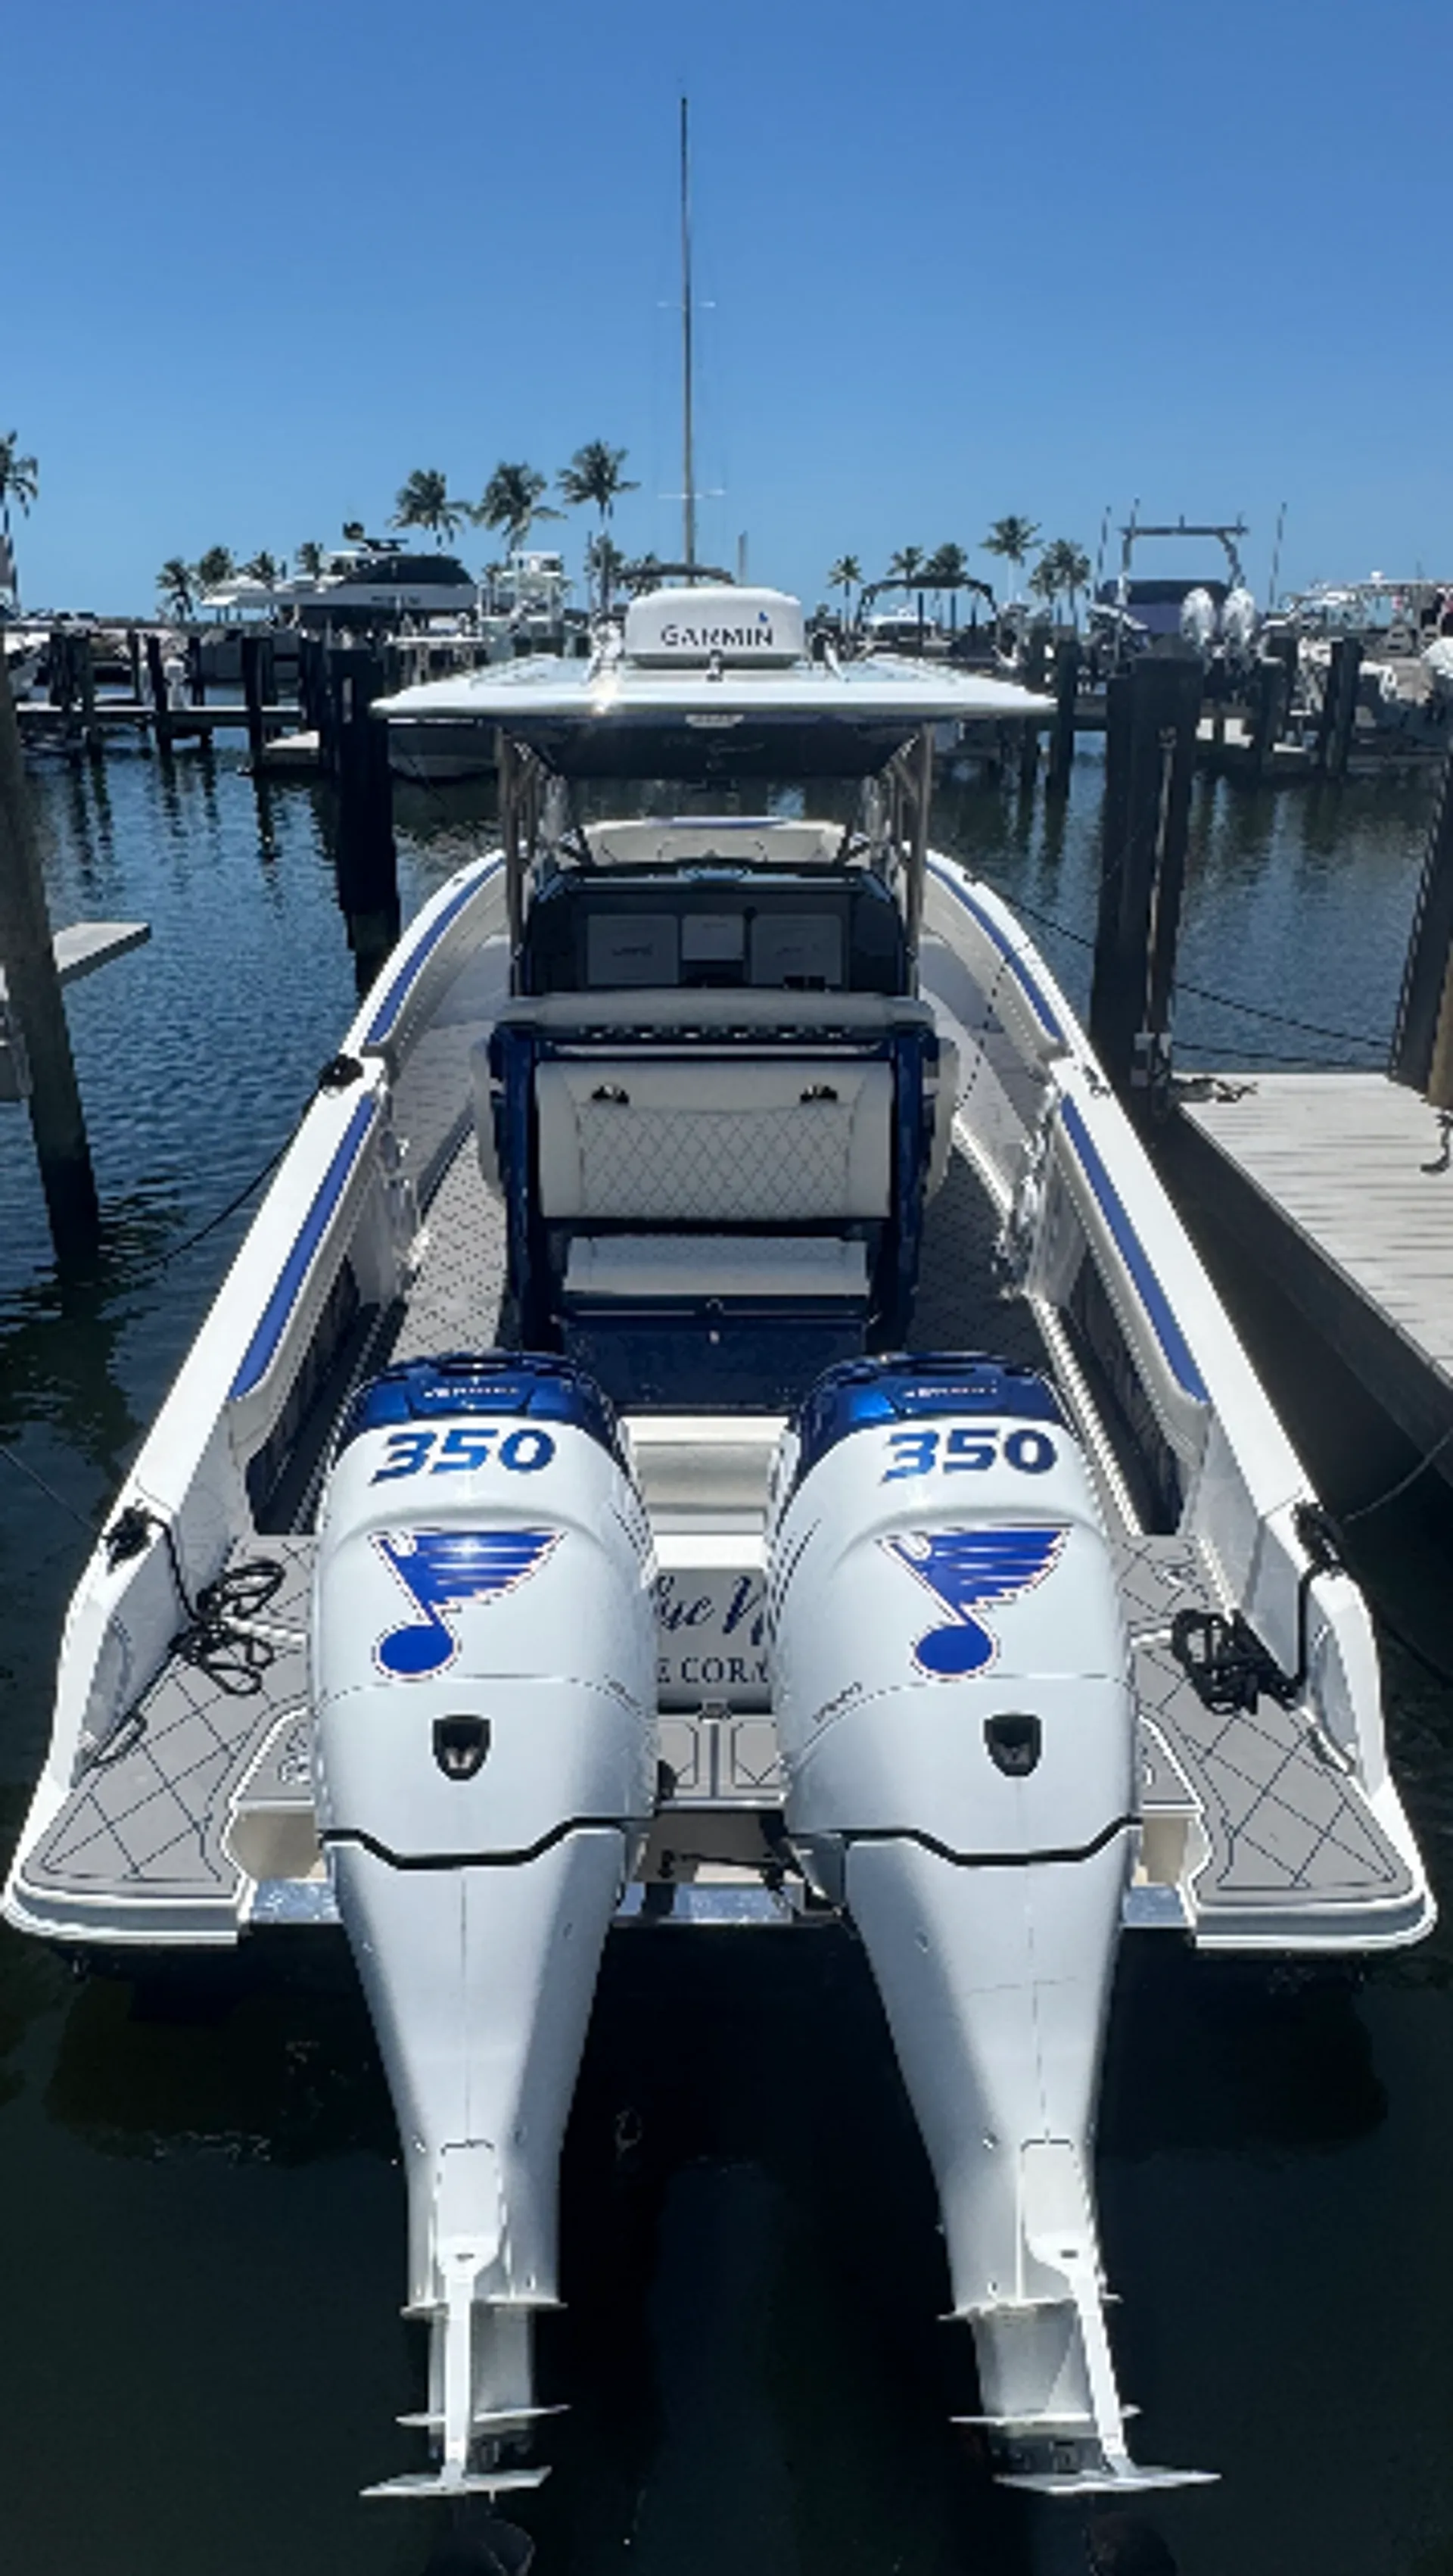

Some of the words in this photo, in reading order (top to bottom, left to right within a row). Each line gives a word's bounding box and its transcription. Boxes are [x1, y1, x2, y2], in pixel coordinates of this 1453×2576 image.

[661, 624, 773, 646] GARMIN
[368, 1428, 557, 1487] 350
[879, 1428, 1059, 1487] 350
[681, 1656, 769, 1684] CORA
